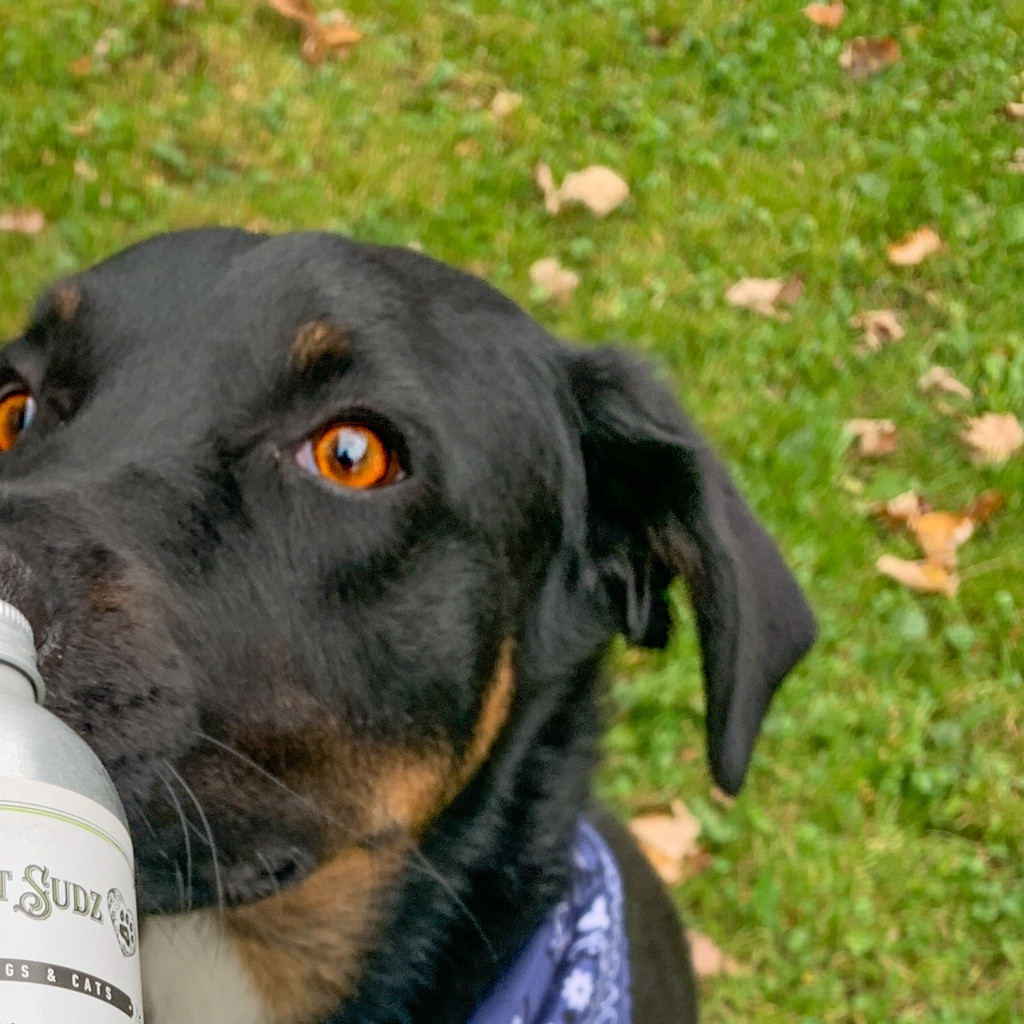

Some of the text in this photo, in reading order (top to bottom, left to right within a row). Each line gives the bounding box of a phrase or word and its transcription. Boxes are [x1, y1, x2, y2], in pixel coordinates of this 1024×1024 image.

[13, 864, 105, 924] SUDZ
[46, 967, 58, 984] &
[71, 973, 115, 1001] CATS
